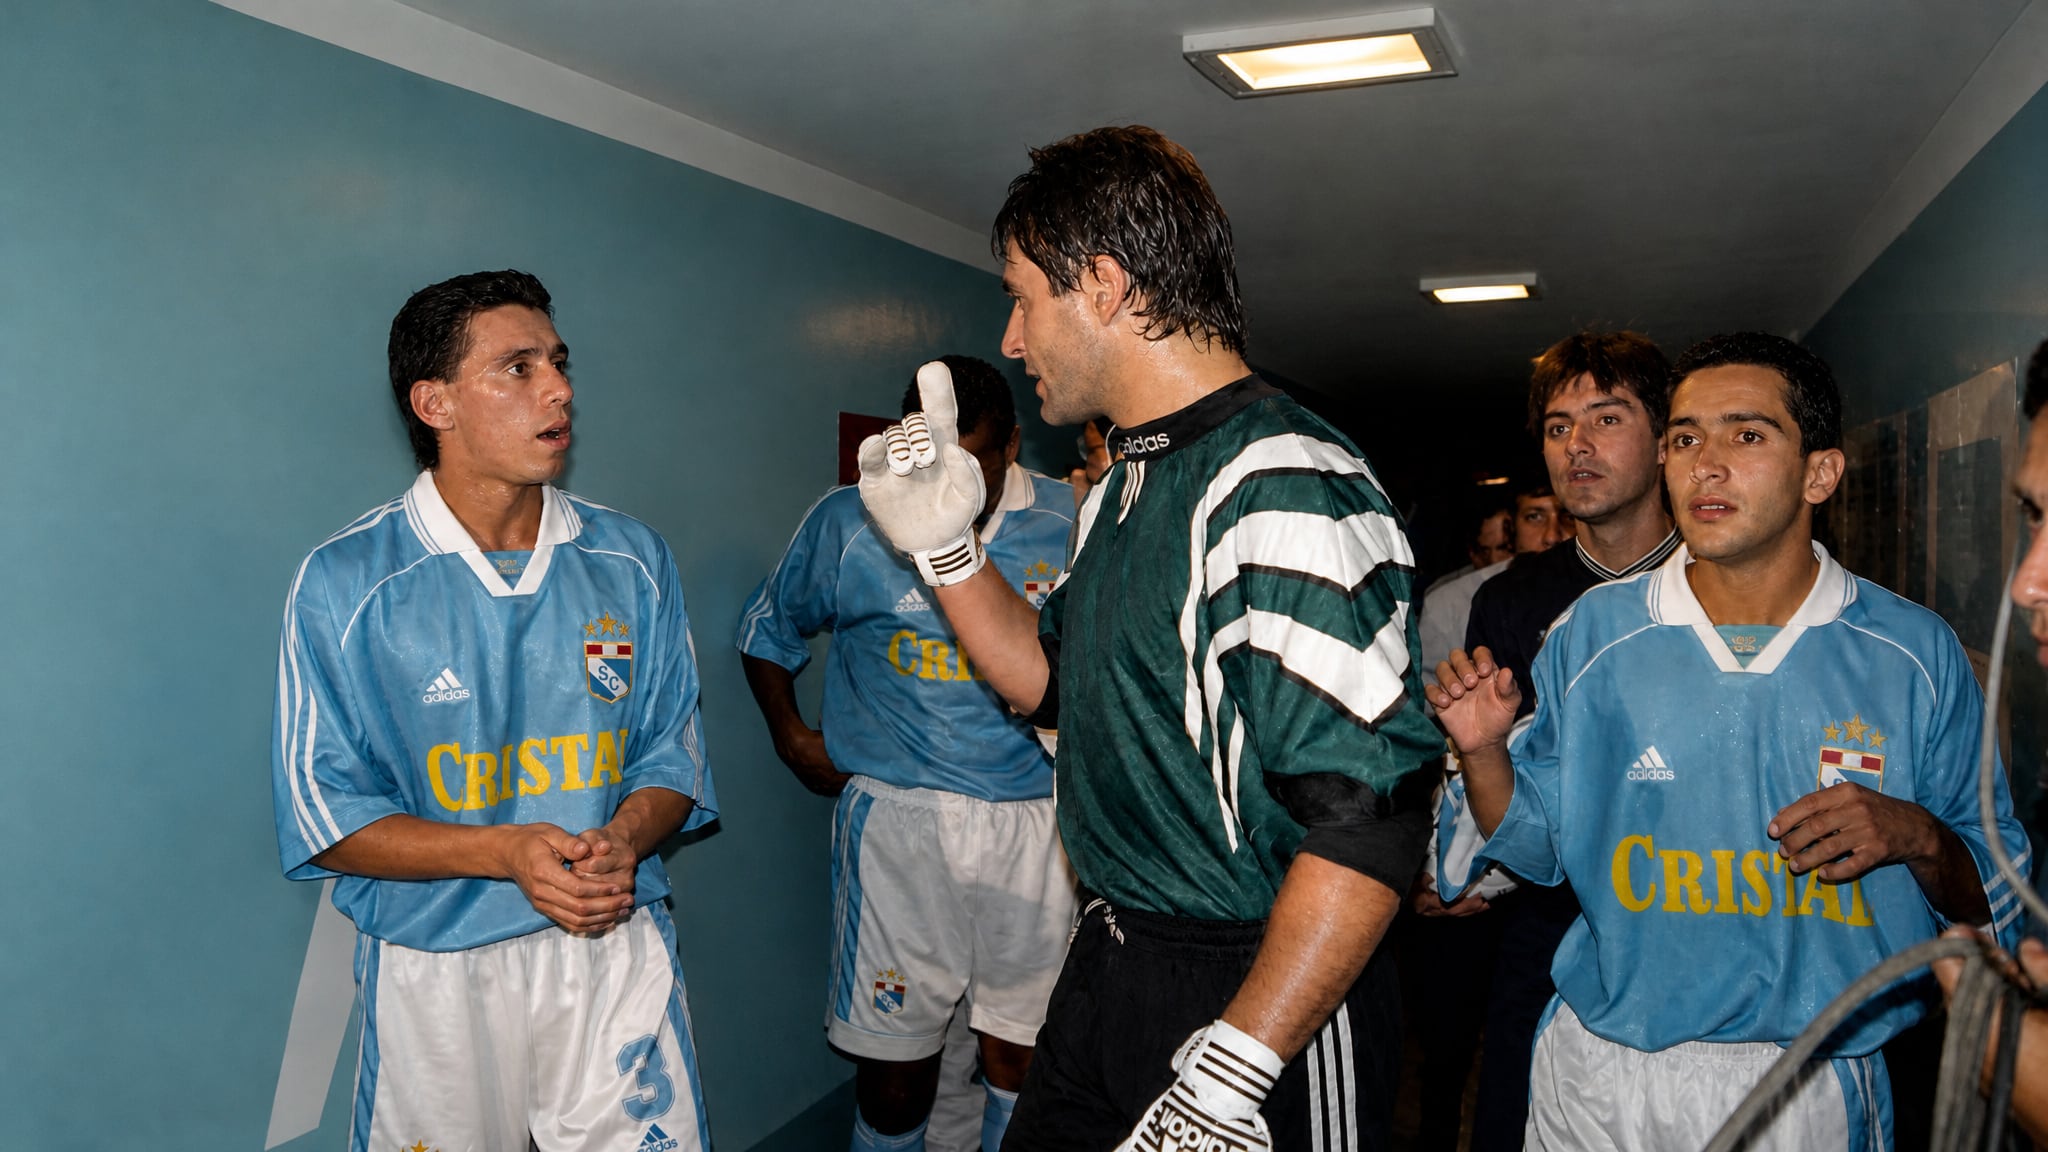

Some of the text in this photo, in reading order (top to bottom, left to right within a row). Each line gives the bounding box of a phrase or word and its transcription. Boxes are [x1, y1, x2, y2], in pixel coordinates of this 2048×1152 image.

[598, 665, 620, 691] SC
[422, 688, 471, 704] adidas
[1626, 767, 1675, 781] adidas
[616, 1033, 676, 1123] 3
